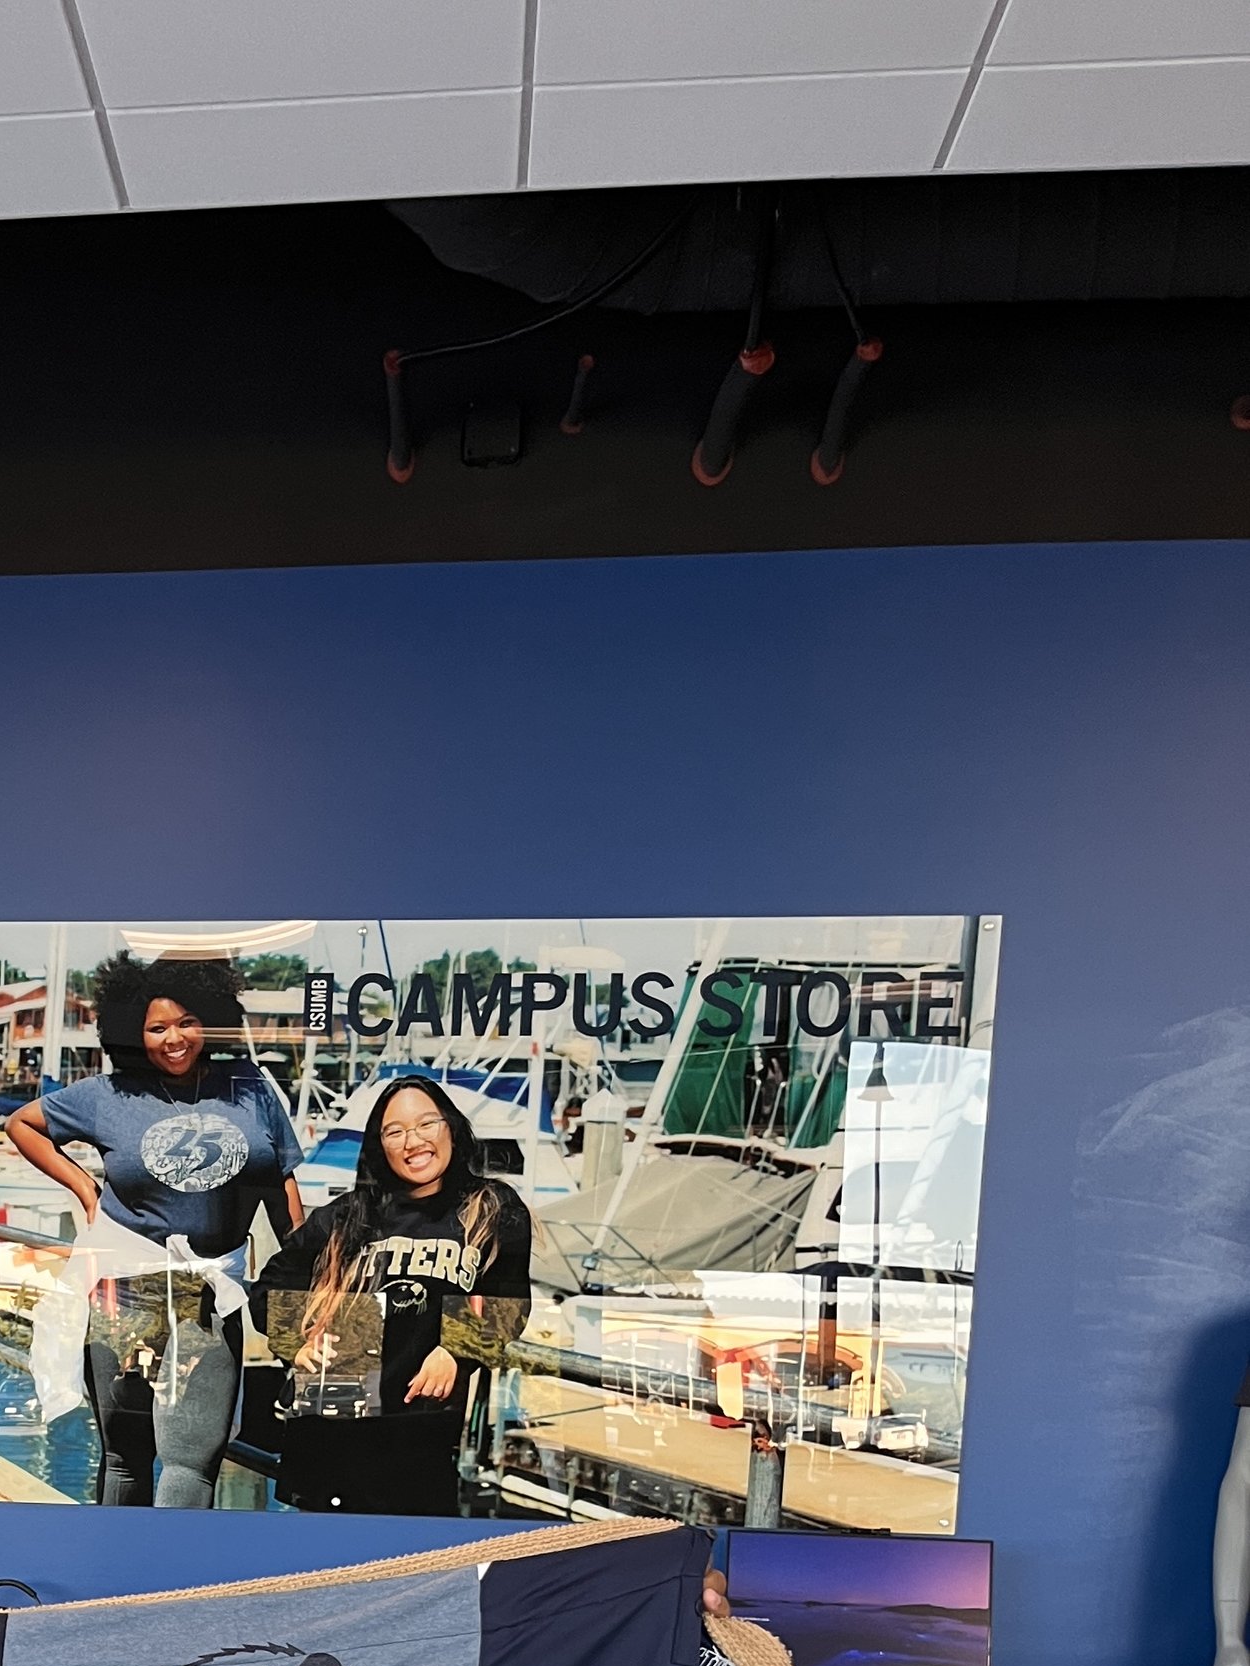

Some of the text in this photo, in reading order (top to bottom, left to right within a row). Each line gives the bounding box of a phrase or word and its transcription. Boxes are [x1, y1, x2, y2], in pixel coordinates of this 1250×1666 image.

[308, 979, 327, 1031] CSUMB
[347, 971, 966, 1037] CAMPUS STORE
